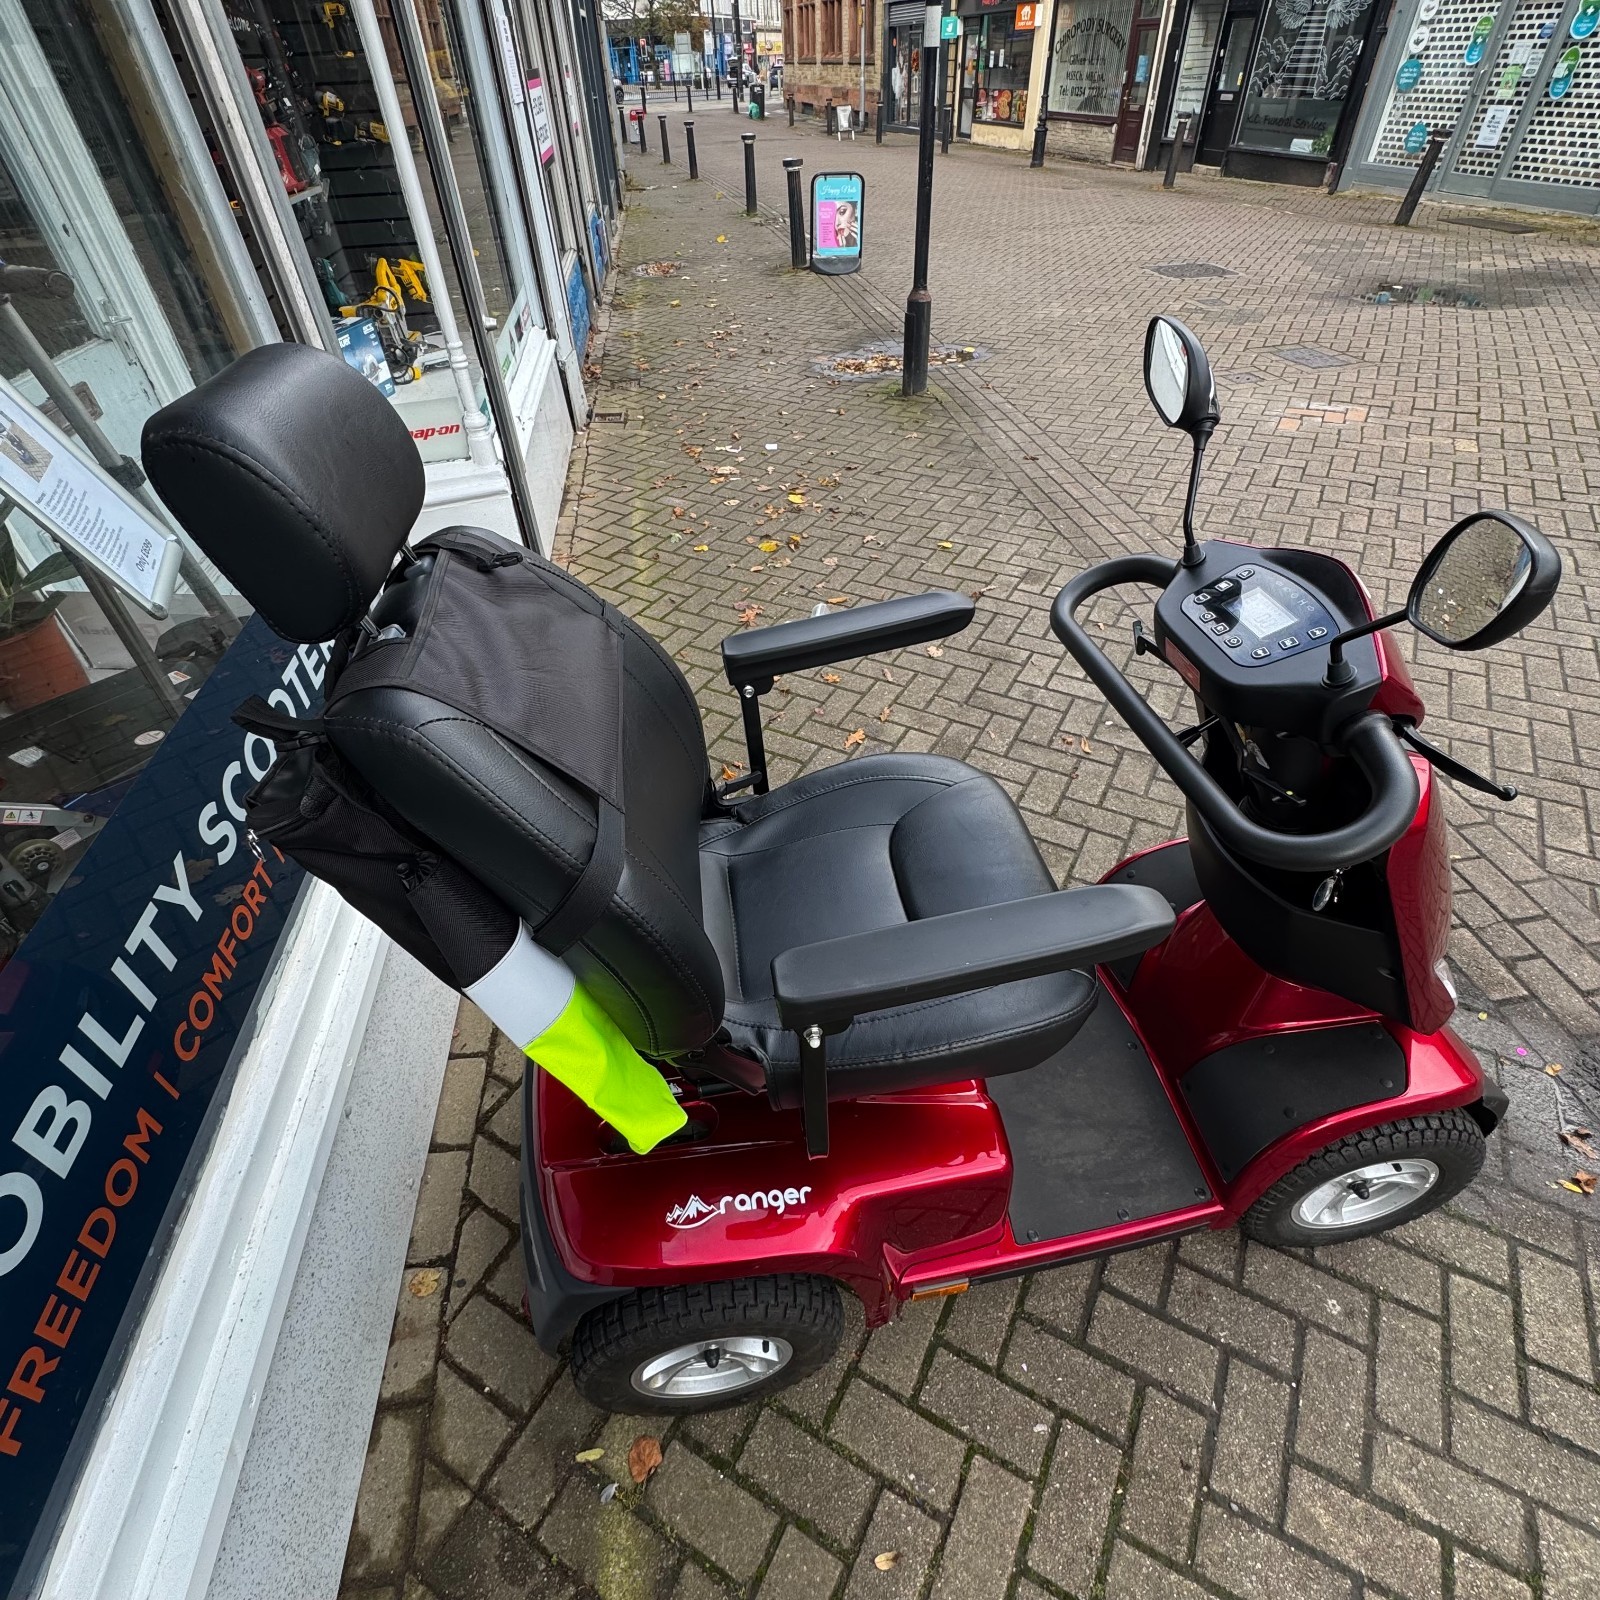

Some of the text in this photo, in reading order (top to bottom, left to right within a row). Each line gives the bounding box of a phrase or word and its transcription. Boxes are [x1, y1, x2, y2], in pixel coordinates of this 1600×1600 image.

[1055, 17, 1127, 54] CHIROPODY SURGERY
[1263, 114, 1292, 128] Funeral
[1292, 117, 1328, 131] Services
[408, 424, 460, 440] nap-on
[140, 538, 153, 559] £699
[135, 555, 150, 572] Only
[0, 858, 274, 1457] FREEDOM COMFORT
[719, 1186, 812, 1215] ranger
